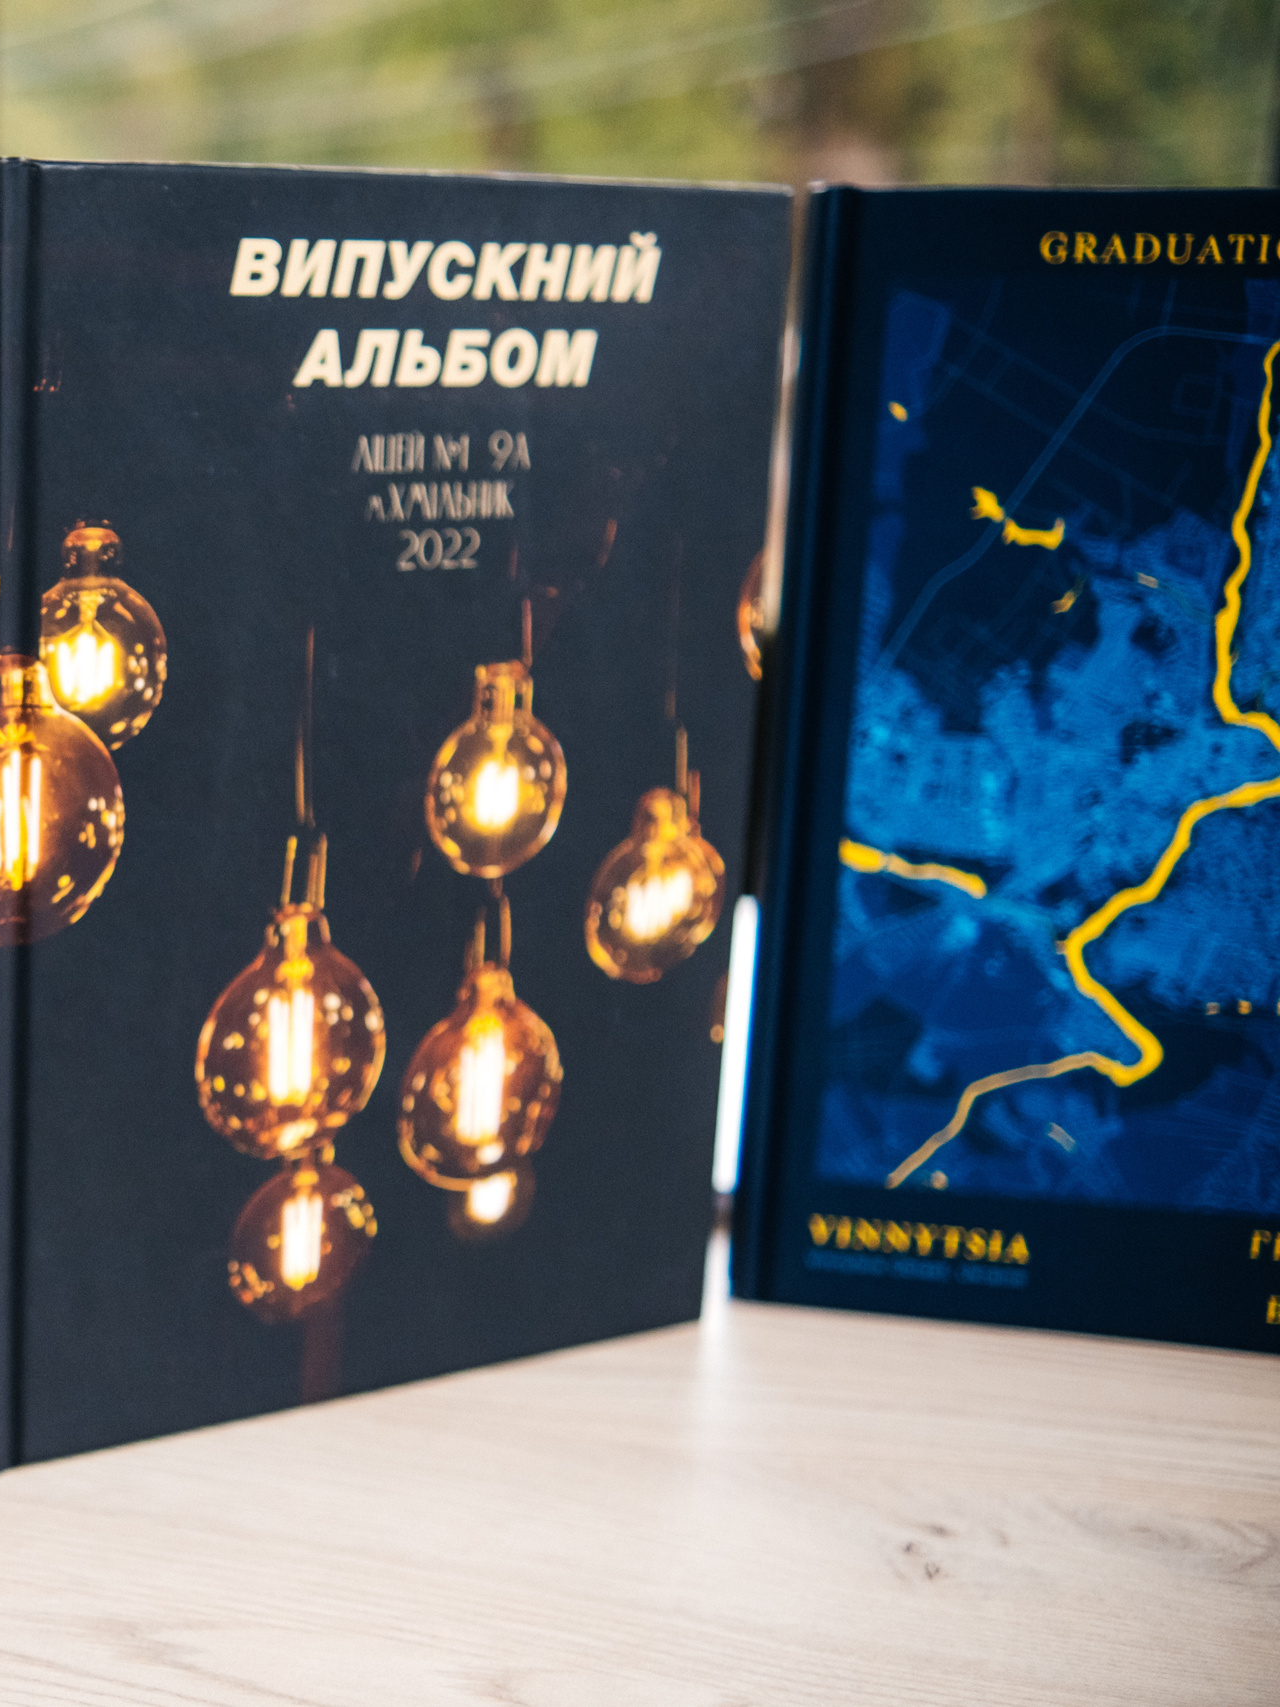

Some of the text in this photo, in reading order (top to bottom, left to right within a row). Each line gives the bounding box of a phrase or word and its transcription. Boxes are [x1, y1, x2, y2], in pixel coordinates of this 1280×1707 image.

[229, 231, 662, 303] ВИПУСКНИЙ
[1038, 230, 1280, 266] GRADUATI
[292, 328, 598, 388] АЛЬБОМ
[395, 526, 481, 572] 2022
[808, 1212, 1030, 1265] VINNYTSIA
